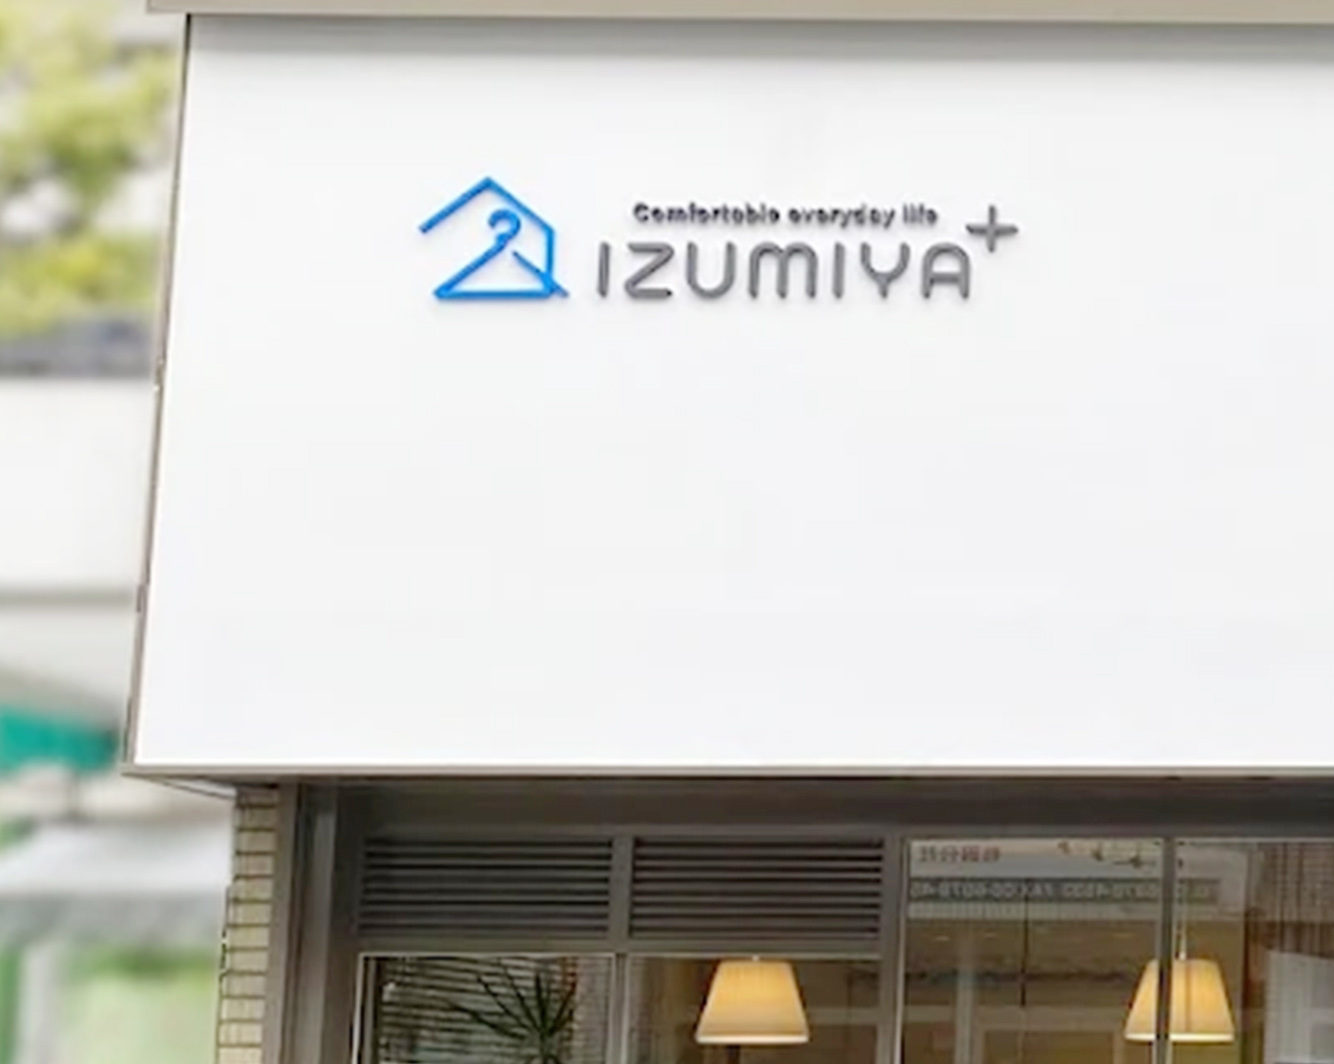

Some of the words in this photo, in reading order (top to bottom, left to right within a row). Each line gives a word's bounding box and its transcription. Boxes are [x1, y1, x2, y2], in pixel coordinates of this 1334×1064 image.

[632, 201, 780, 225] Comfortable
[787, 203, 895, 229] everyday
[902, 202, 939, 225] life
